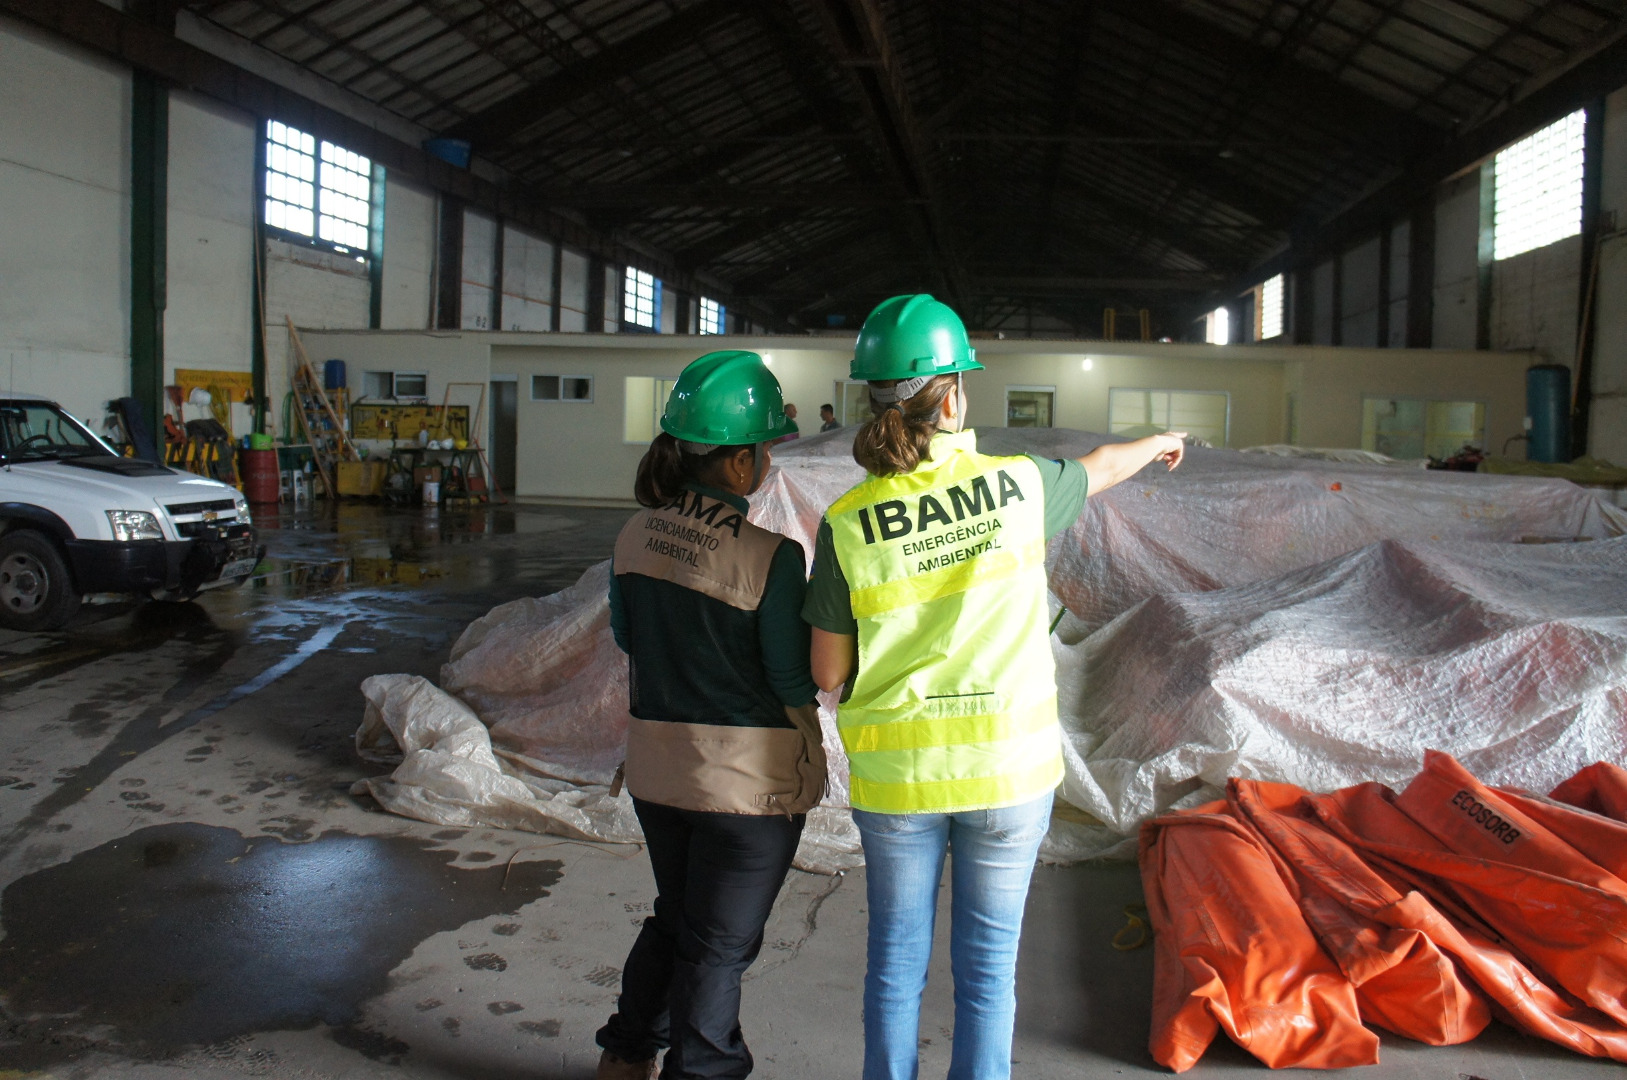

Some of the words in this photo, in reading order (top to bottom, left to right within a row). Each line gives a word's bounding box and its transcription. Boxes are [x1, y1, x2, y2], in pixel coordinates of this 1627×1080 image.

[664, 490, 743, 539] AMA
[858, 469, 1025, 545] IBAMA
[645, 517, 720, 551] LICENCIAMENTO
[645, 537, 699, 568] AMBIENTAL
[902, 518, 1002, 556] EMERGÊNCIA
[917, 538, 1002, 573] AMBIENTAL
[1451, 790, 1521, 844] ECOSORB
